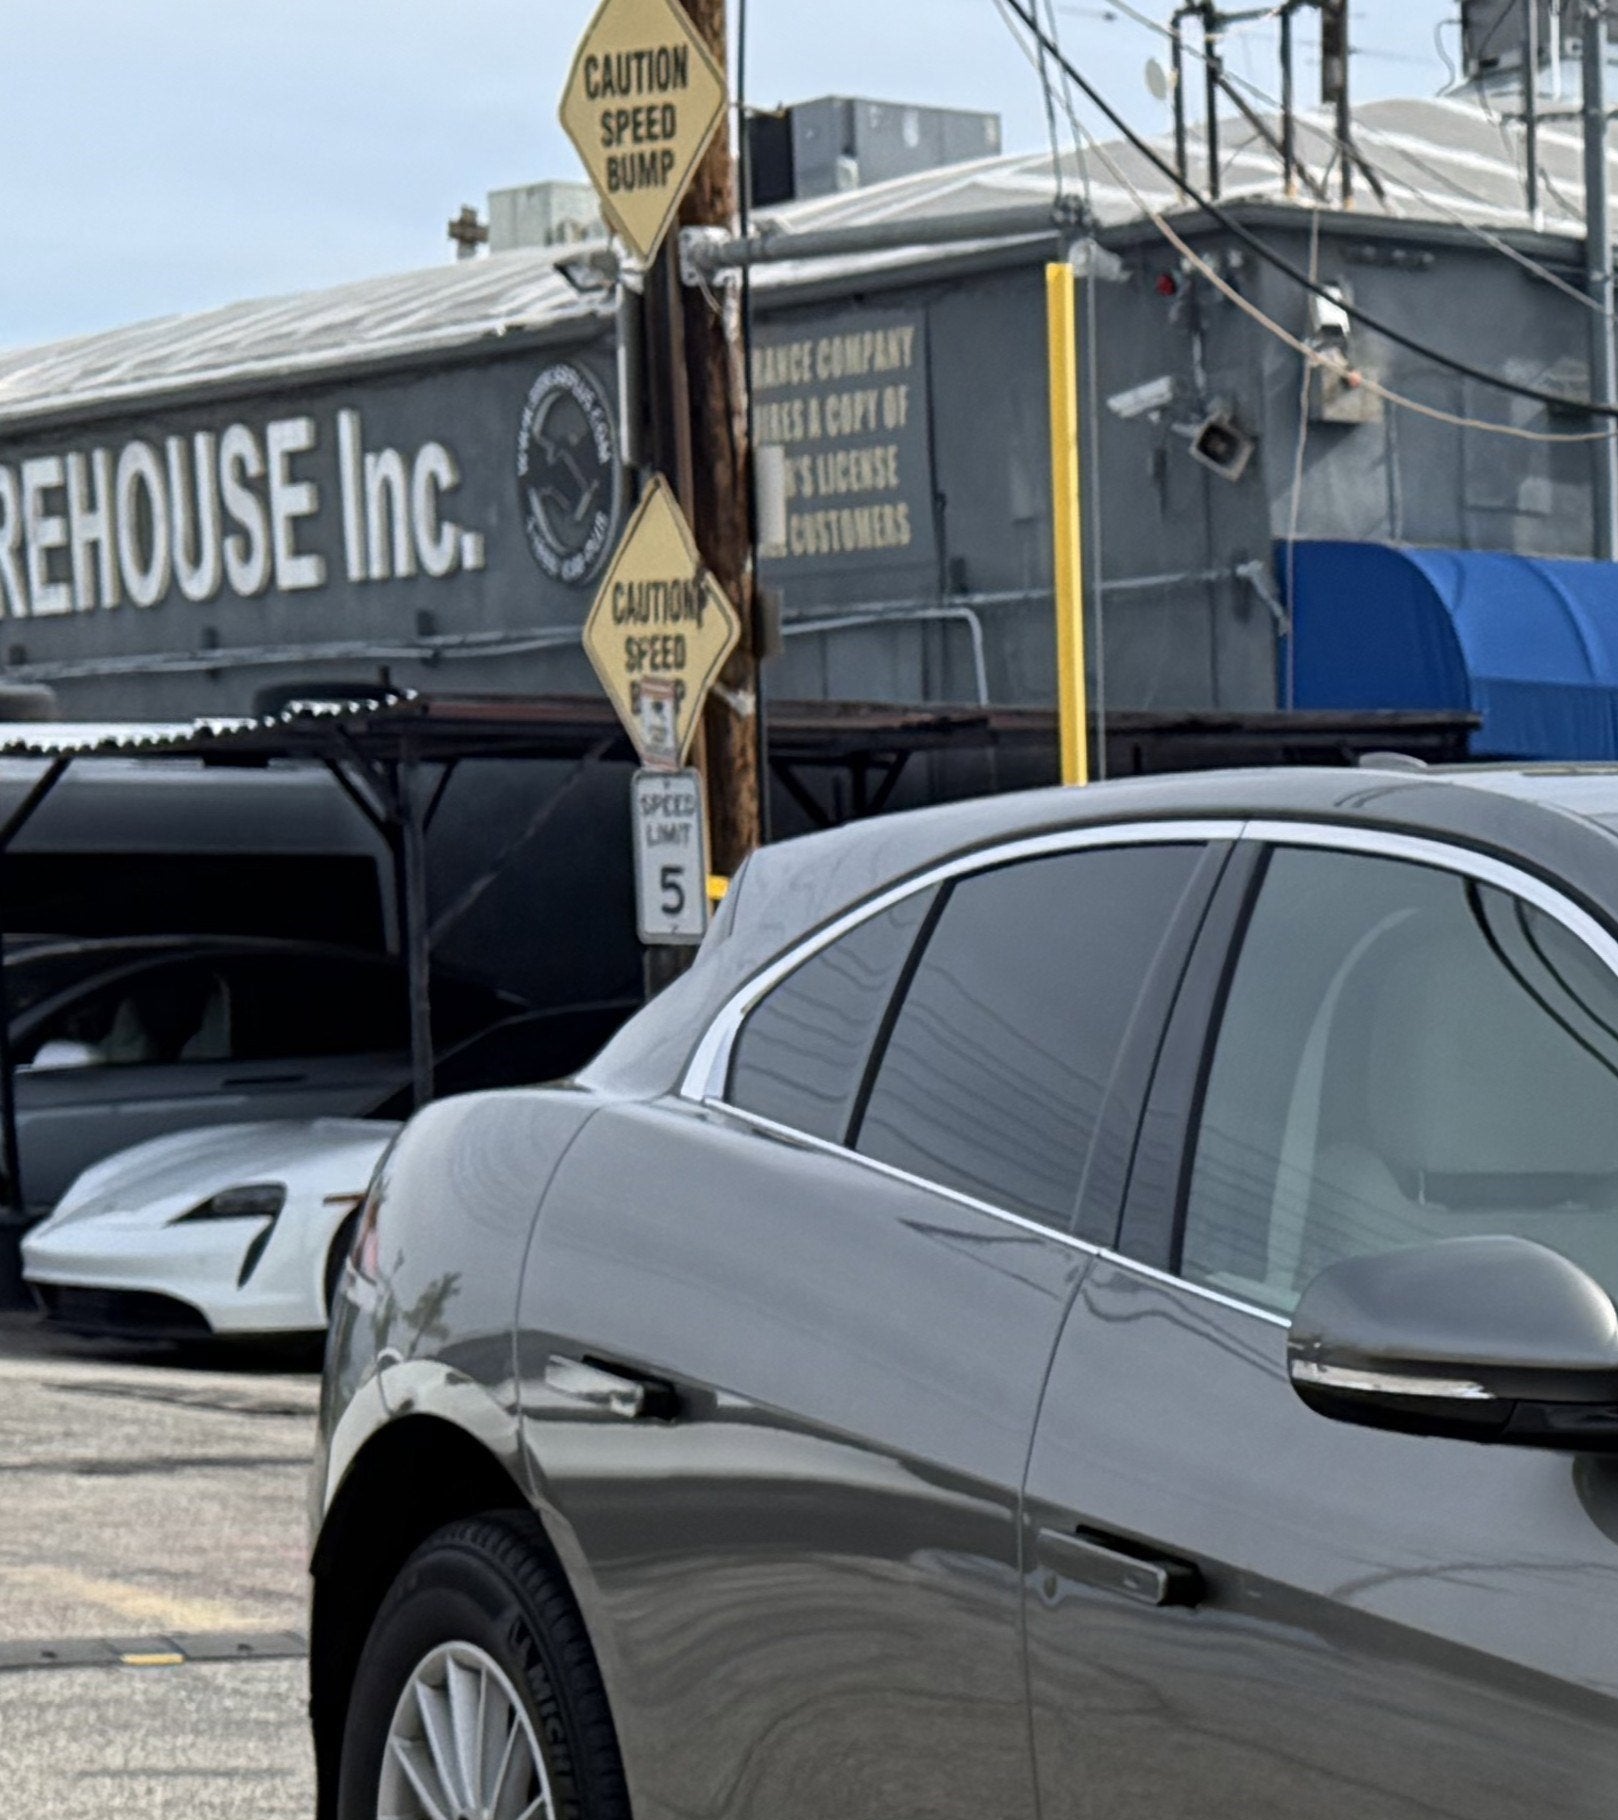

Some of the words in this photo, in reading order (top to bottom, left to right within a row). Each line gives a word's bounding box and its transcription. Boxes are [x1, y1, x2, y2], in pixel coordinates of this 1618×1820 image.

[584, 43, 689, 100] CAUTION
[601, 103, 677, 147] SPEED
[606, 149, 675, 193] BUMP
[816, 324, 915, 381] COMPANY
[808, 395, 823, 440] A
[825, 388, 878, 438] COPY
[882, 384, 908, 431] OF
[338, 408, 486, 582] Inc.
[816, 444, 898, 496] LICENSE
[790, 501, 911, 557] CUSTOMERS
[612, 578, 704, 627] CAUTION
[625, 633, 686, 673] SPEED
[640, 793, 695, 818] SPEED
[646, 821, 692, 848] LIMIT
[660, 865, 685, 916] 5
